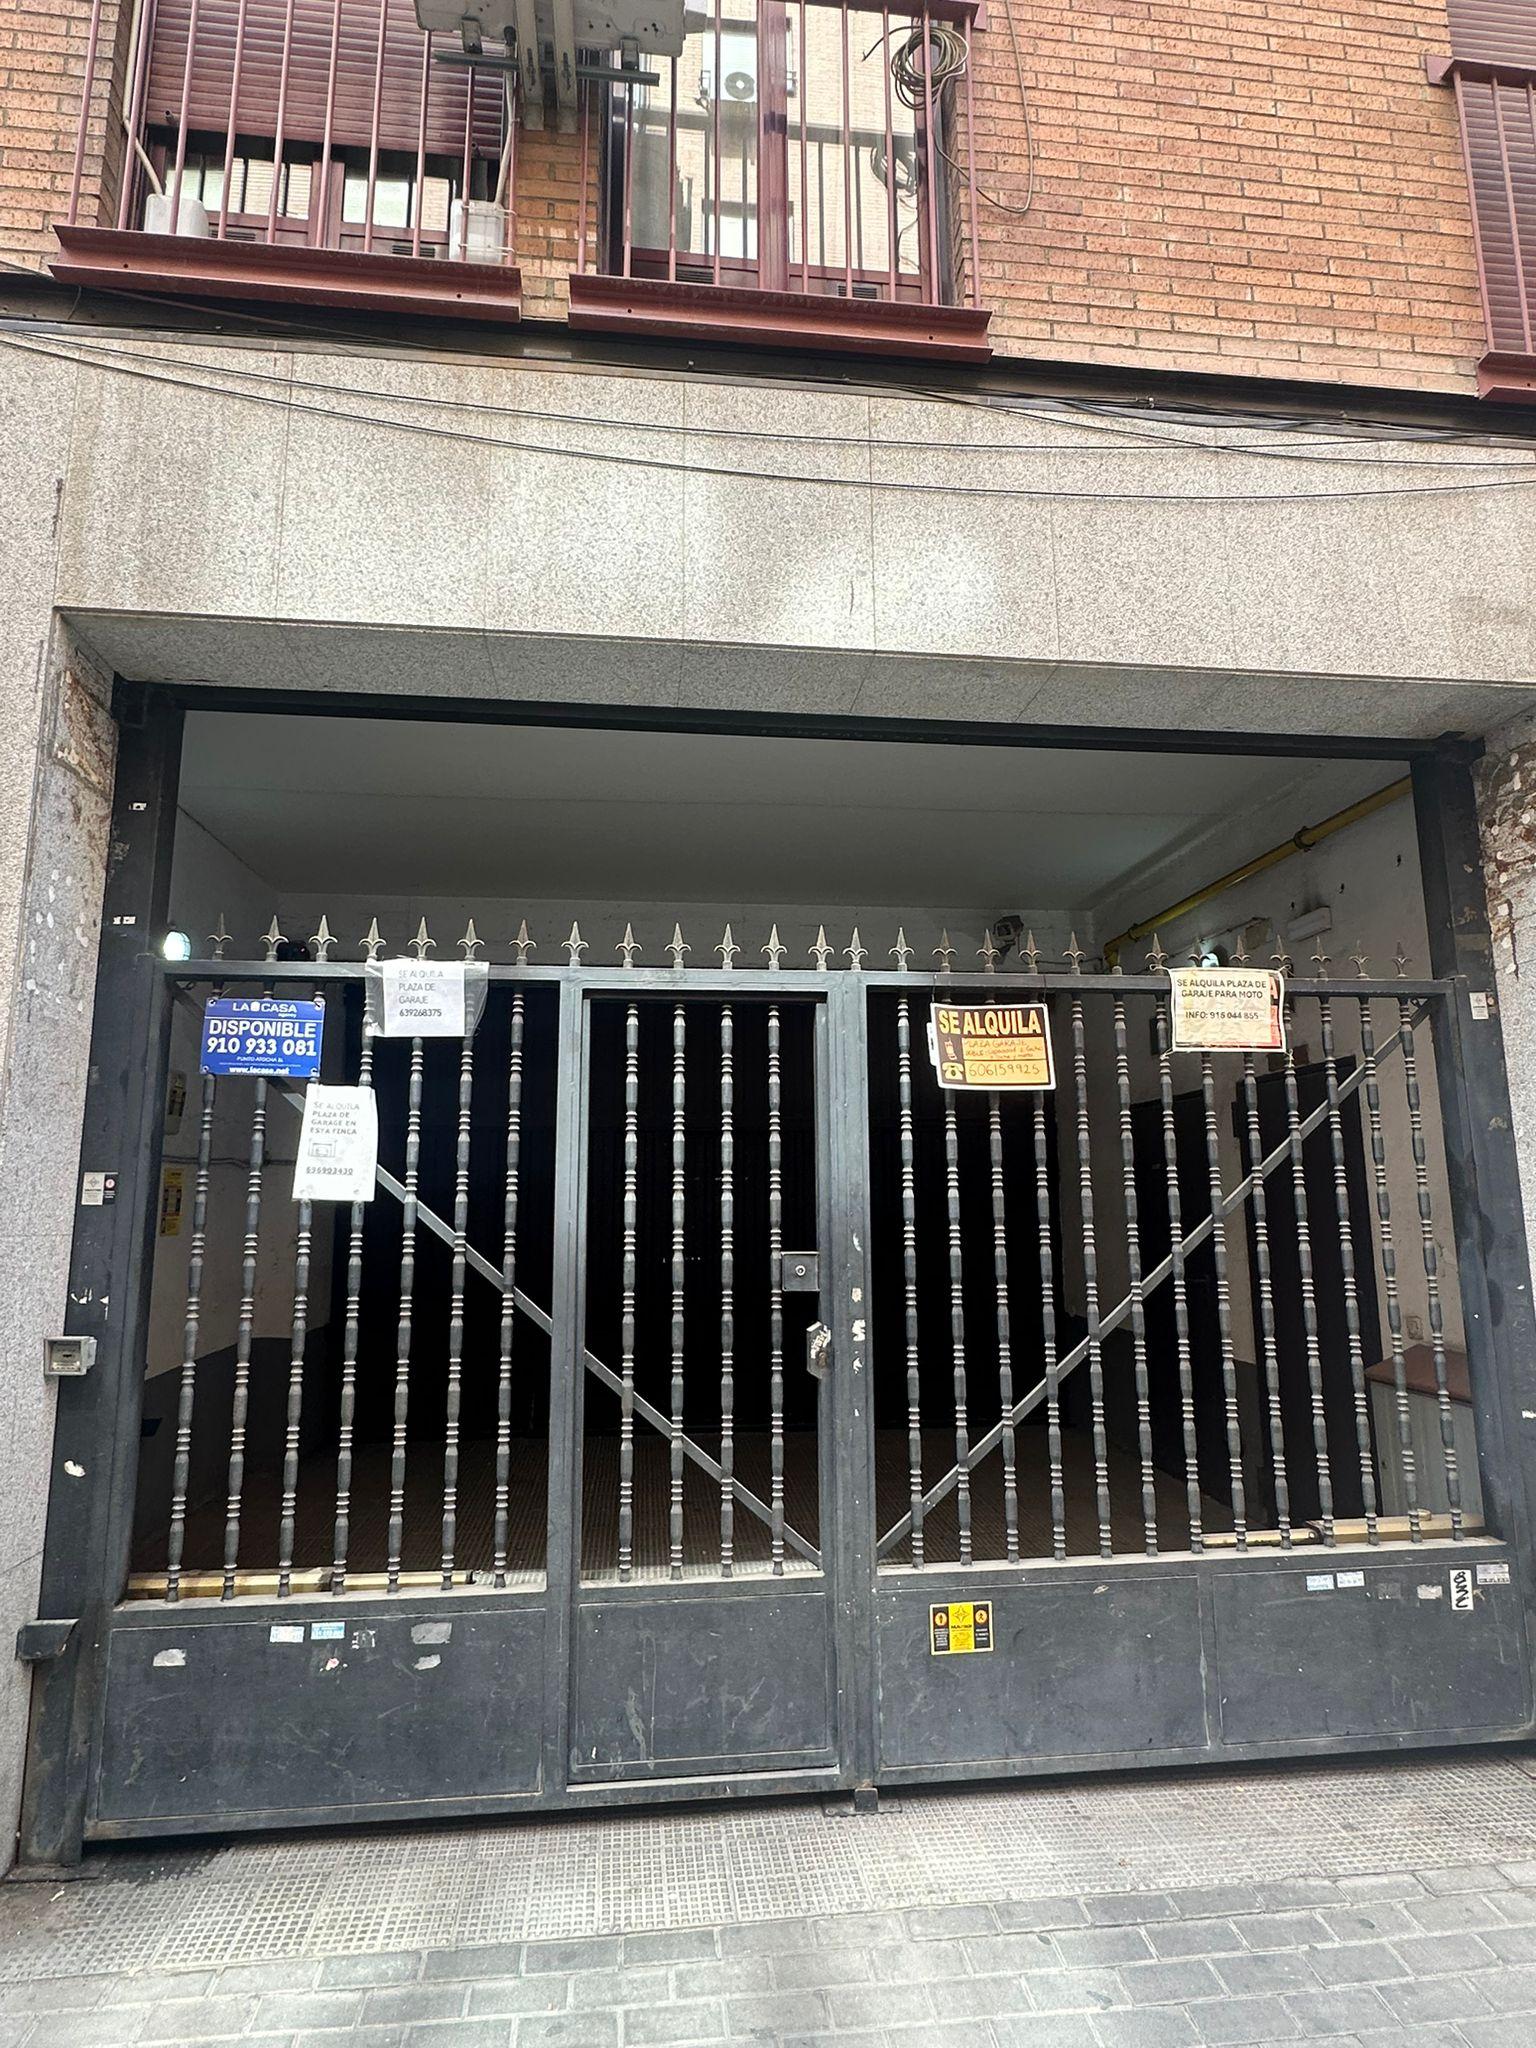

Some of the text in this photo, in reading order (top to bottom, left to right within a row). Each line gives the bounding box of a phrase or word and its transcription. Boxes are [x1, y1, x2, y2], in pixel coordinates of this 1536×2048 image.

[398, 982, 436, 991] PLAZA DE
[1177, 979, 1267, 988] SE ALQUILA PLAZA DE
[1181, 989, 1263, 999] GARAJE PARA MOTO
[398, 995, 429, 1004] GARAJE
[232, 1002, 297, 1013] LA CASA
[1185, 1011, 1208, 1019] INFO:
[1226, 1011, 1243, 1019] 044
[939, 1010, 1042, 1036] SE ALQUILA
[209, 1020, 317, 1038] DISPONIBLE
[207, 1036, 317, 1057] 910 933 081
[312, 1110, 337, 1118] PLAZA
